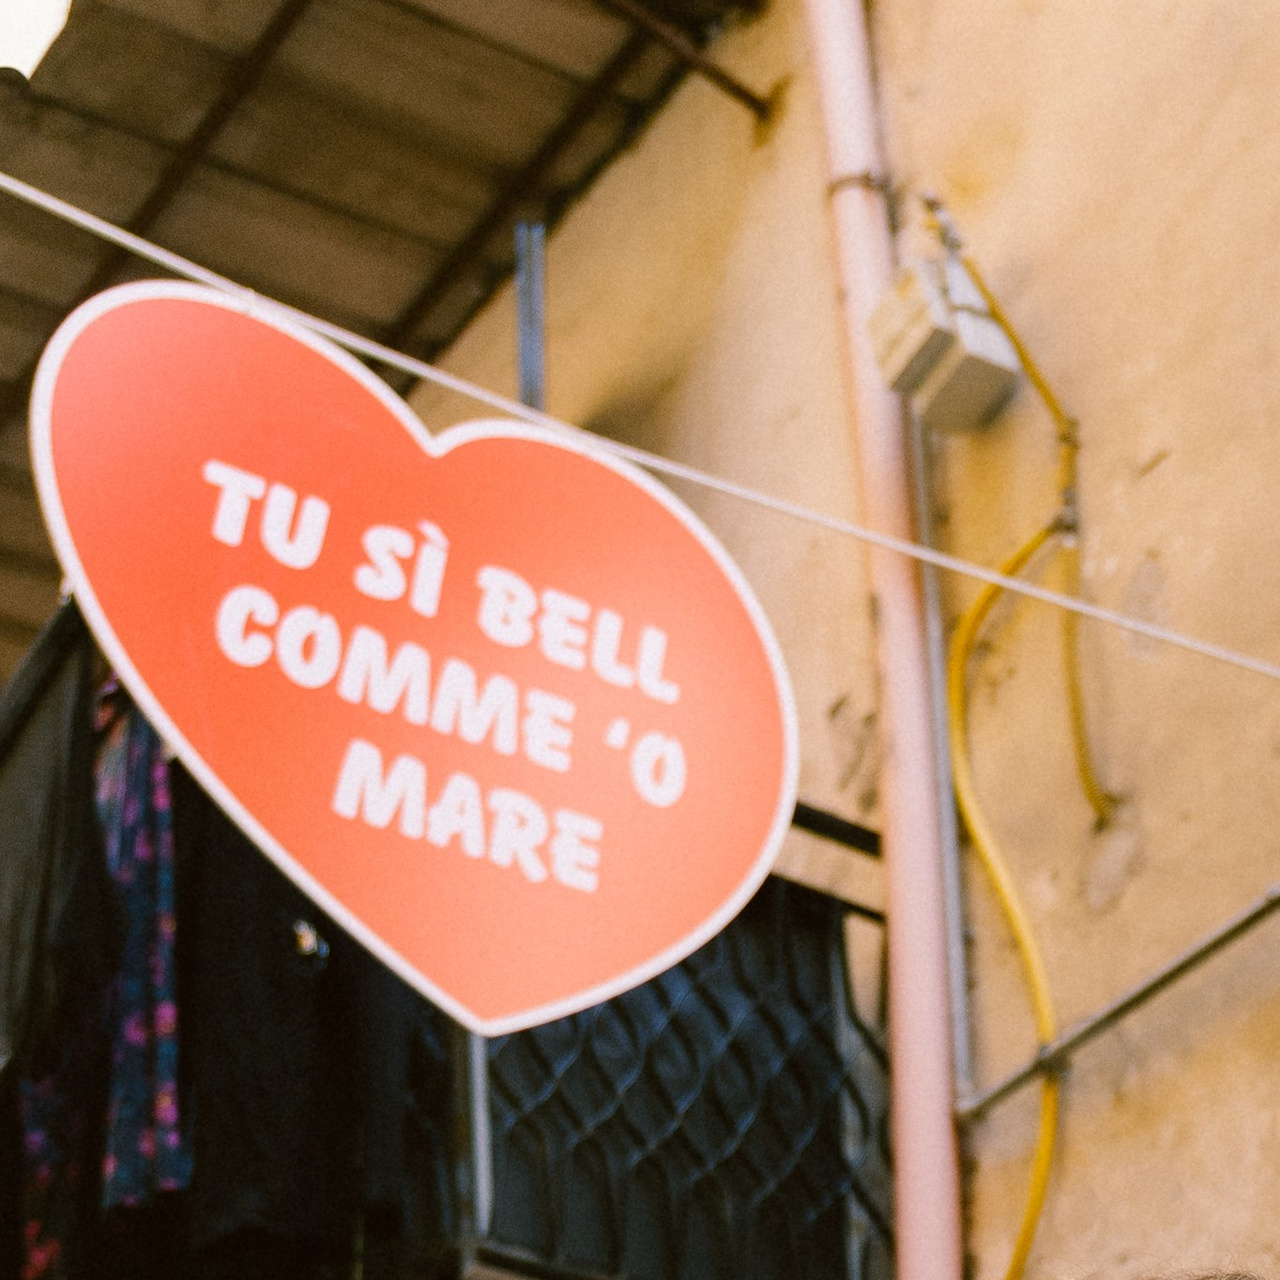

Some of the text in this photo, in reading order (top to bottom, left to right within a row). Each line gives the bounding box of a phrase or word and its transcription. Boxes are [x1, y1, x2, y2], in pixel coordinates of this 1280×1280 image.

[203, 458, 680, 705] TU SÌ BELL
[216, 584, 576, 774] COMME
[332, 738, 603, 893] MARE
